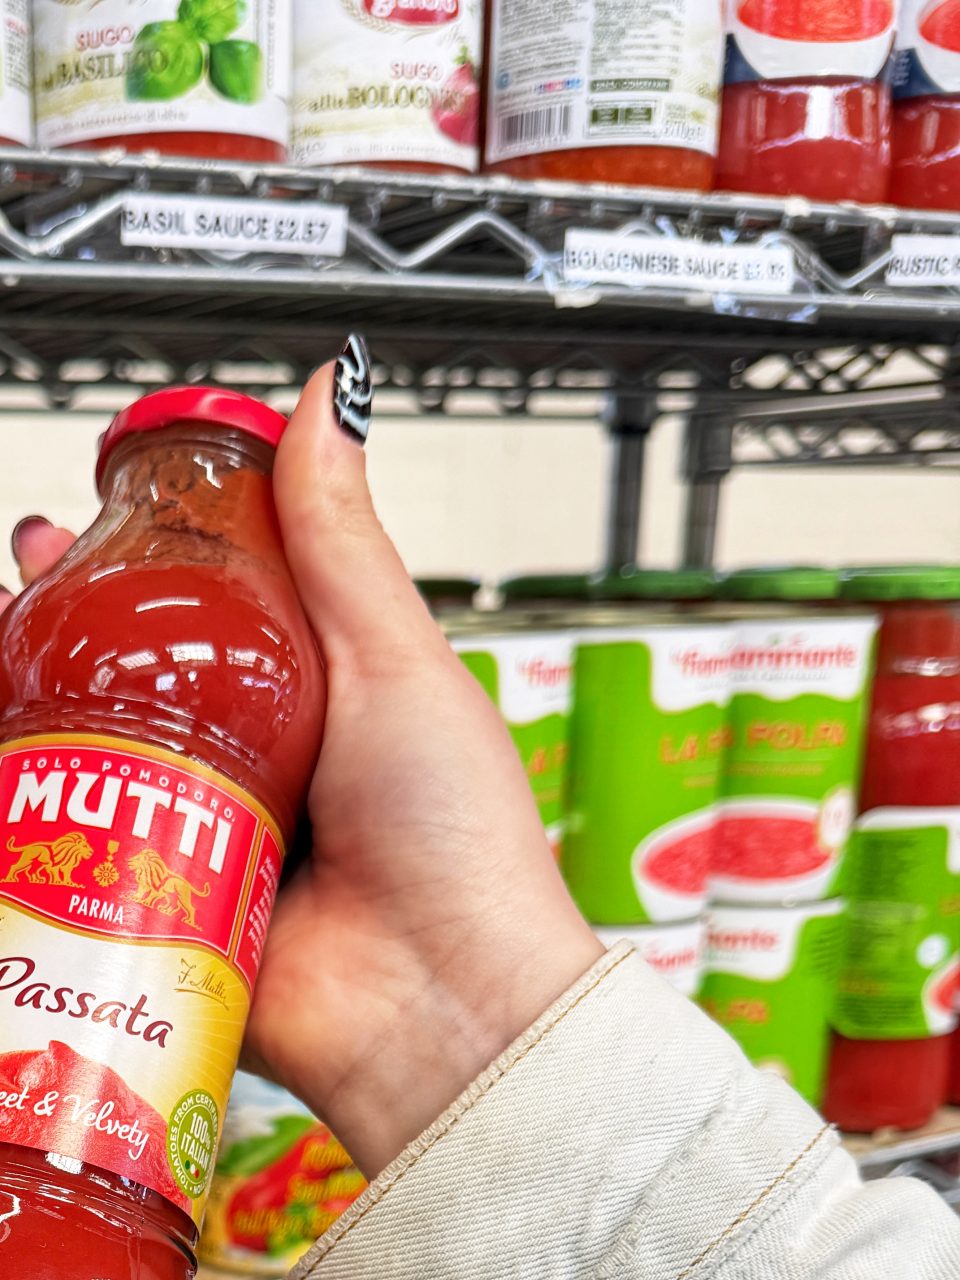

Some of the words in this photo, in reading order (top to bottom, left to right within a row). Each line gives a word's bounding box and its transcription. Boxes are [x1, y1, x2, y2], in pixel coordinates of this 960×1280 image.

[76, 26, 134, 51] SUGO
[123, 210, 187, 237] BASIL
[196, 213, 269, 243] SAUCE
[22, 757, 82, 773] SOLO
[7, 771, 233, 875] MUTTI
[68, 894, 126, 926] PARMA
[33, 1090, 56, 1117] &
[63, 1093, 150, 1160] Velvety
[173, 1096, 194, 1124] FROM
[170, 1126, 189, 1191] TOMATOES
